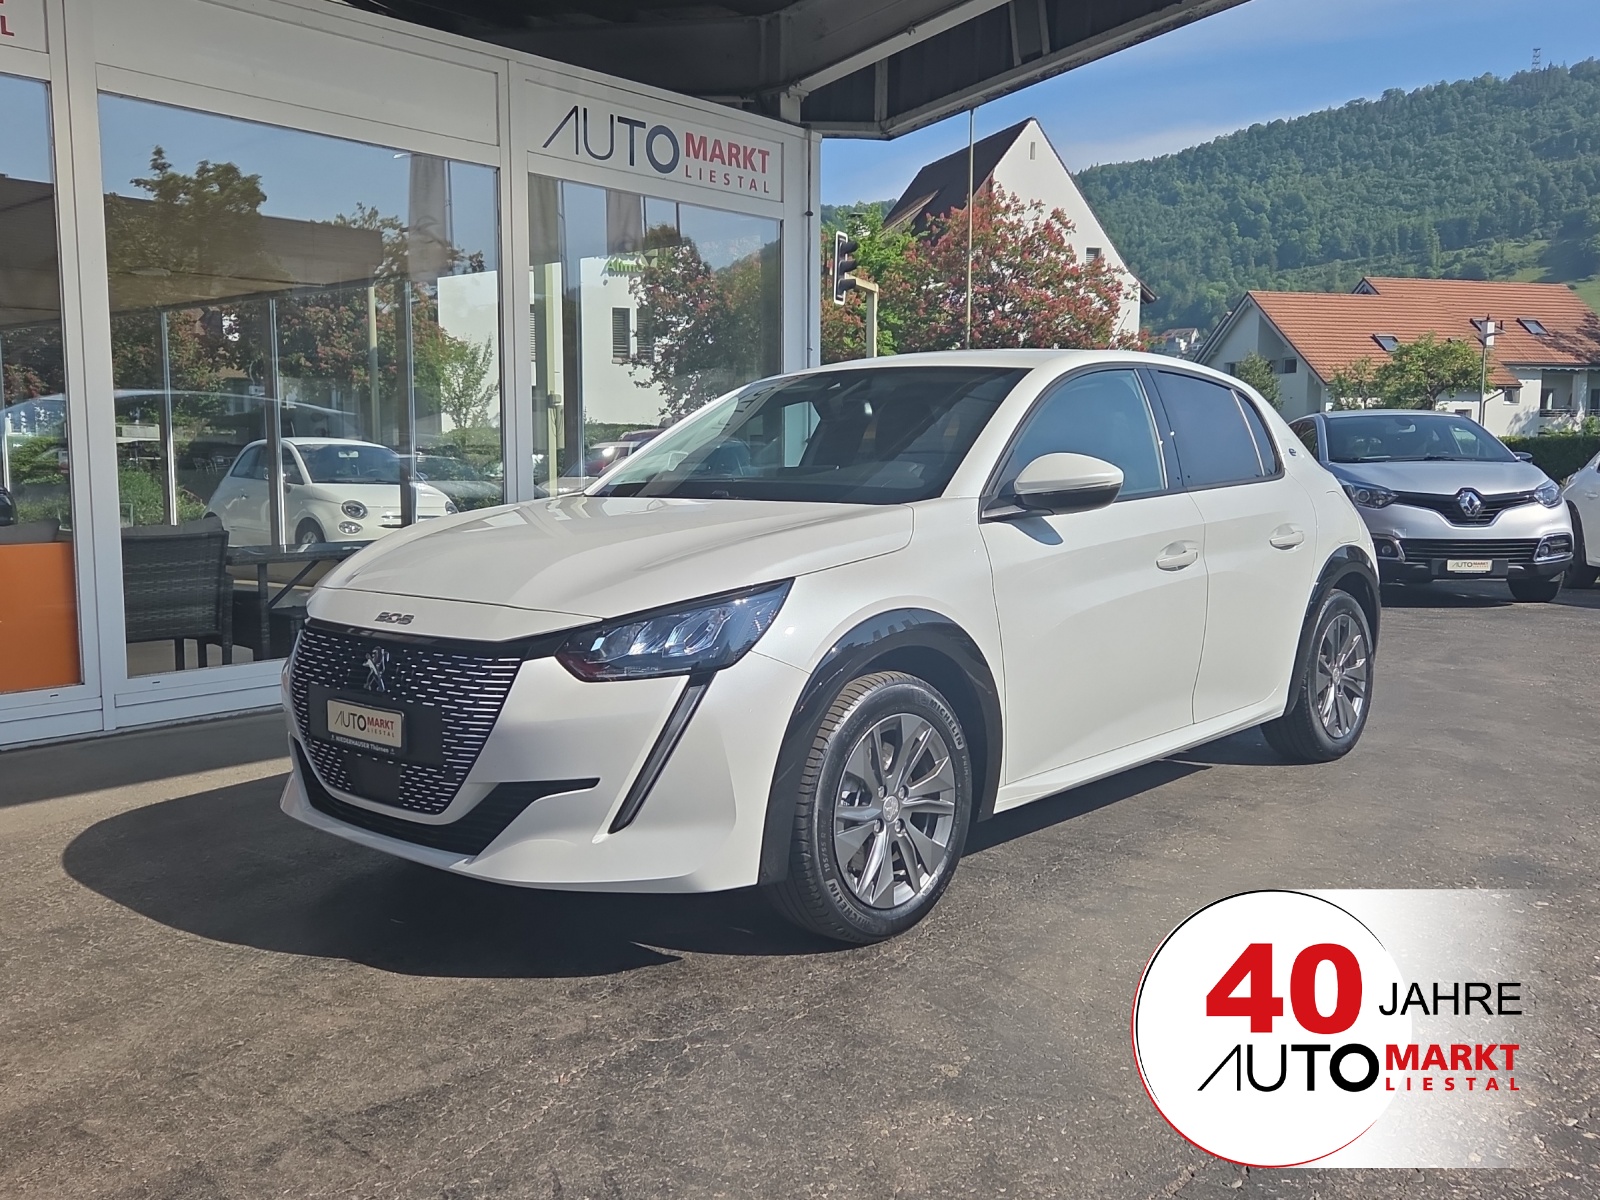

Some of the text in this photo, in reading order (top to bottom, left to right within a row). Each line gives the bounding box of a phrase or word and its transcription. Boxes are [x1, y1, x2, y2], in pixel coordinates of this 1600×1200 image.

[542, 105, 770, 174] AUTO MARKT
[685, 164, 770, 194] LIESTAL
[334, 710, 394, 732] AUTO MARKT
[367, 728, 395, 738] LIESTAL
[928, 699, 963, 747] MICHELIN
